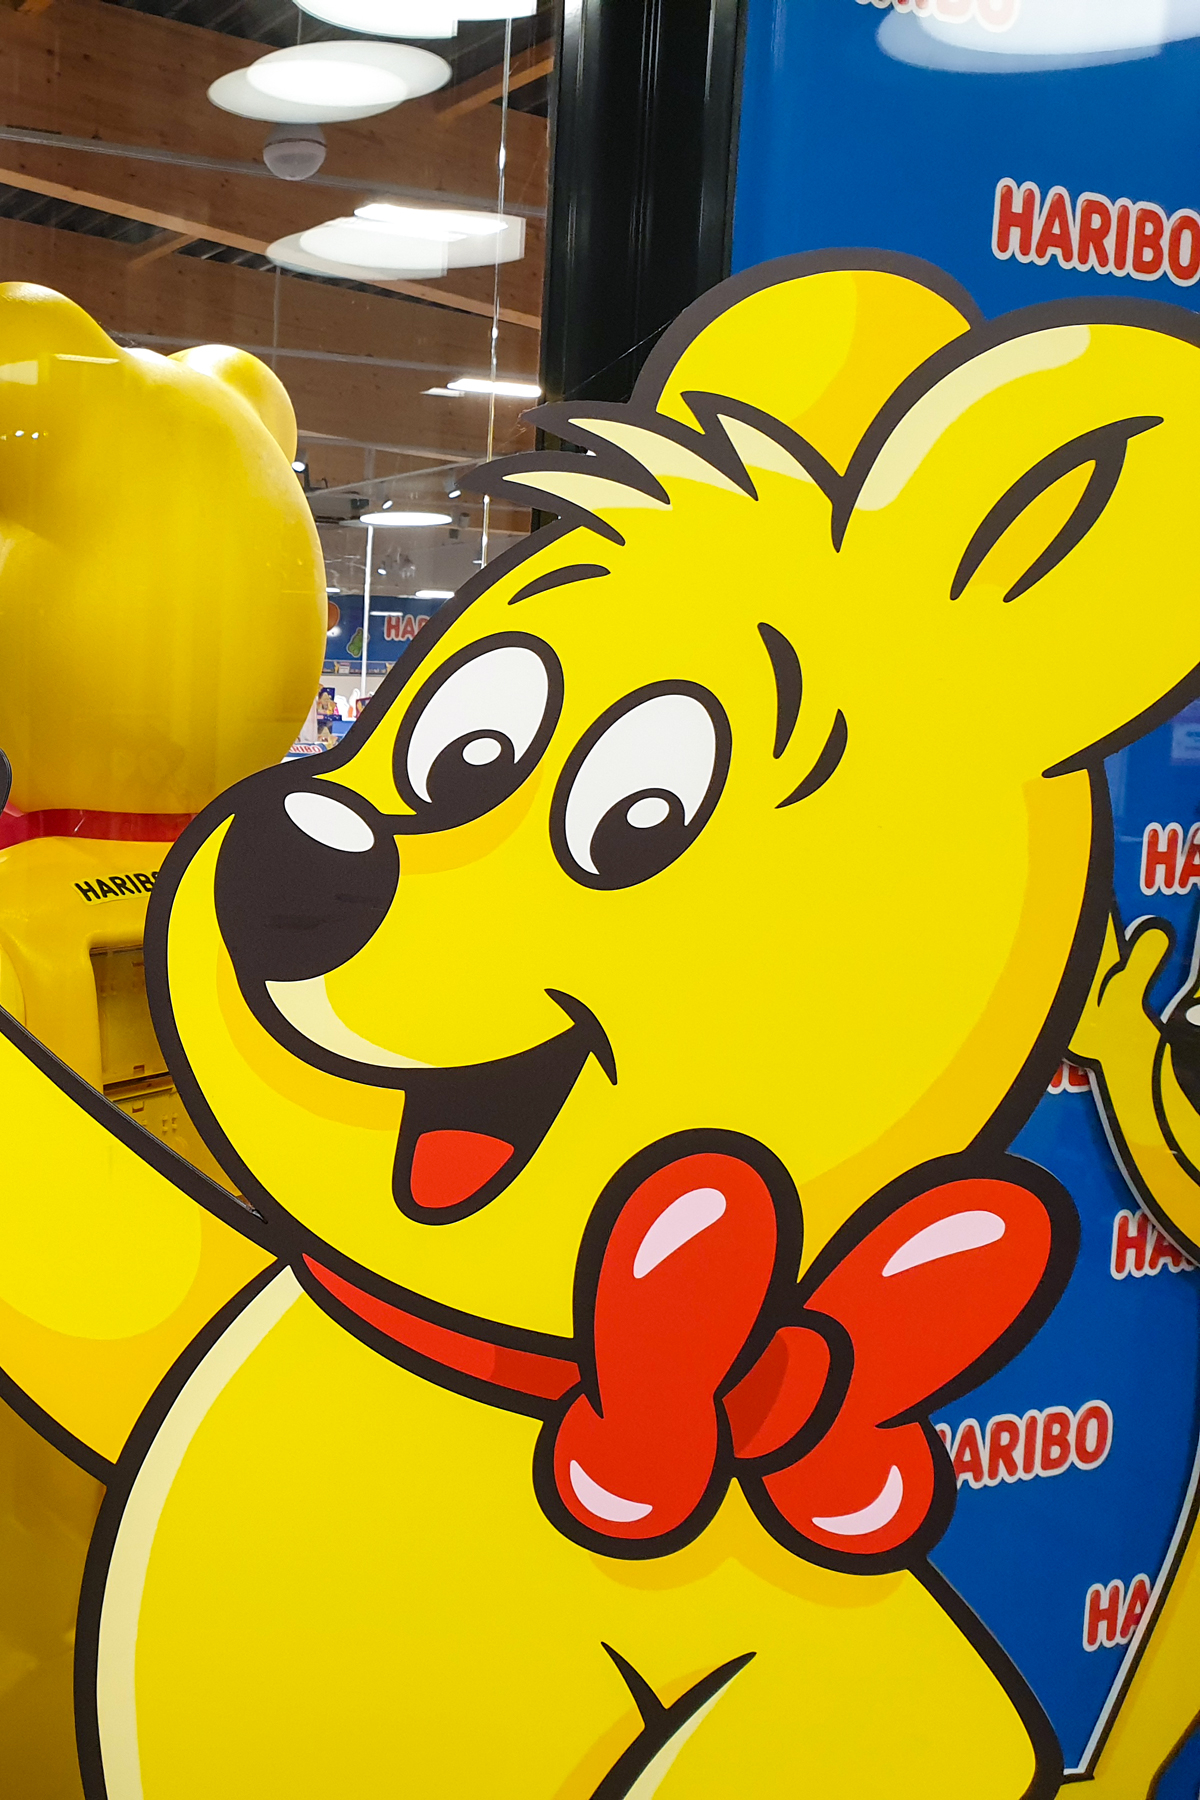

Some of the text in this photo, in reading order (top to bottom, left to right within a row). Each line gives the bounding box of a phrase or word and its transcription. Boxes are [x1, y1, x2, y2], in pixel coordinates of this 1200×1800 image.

[993, 178, 1200, 286] HARIBO
[74, 871, 160, 902] HARIB
[935, 1400, 1113, 1489] ARIBO
